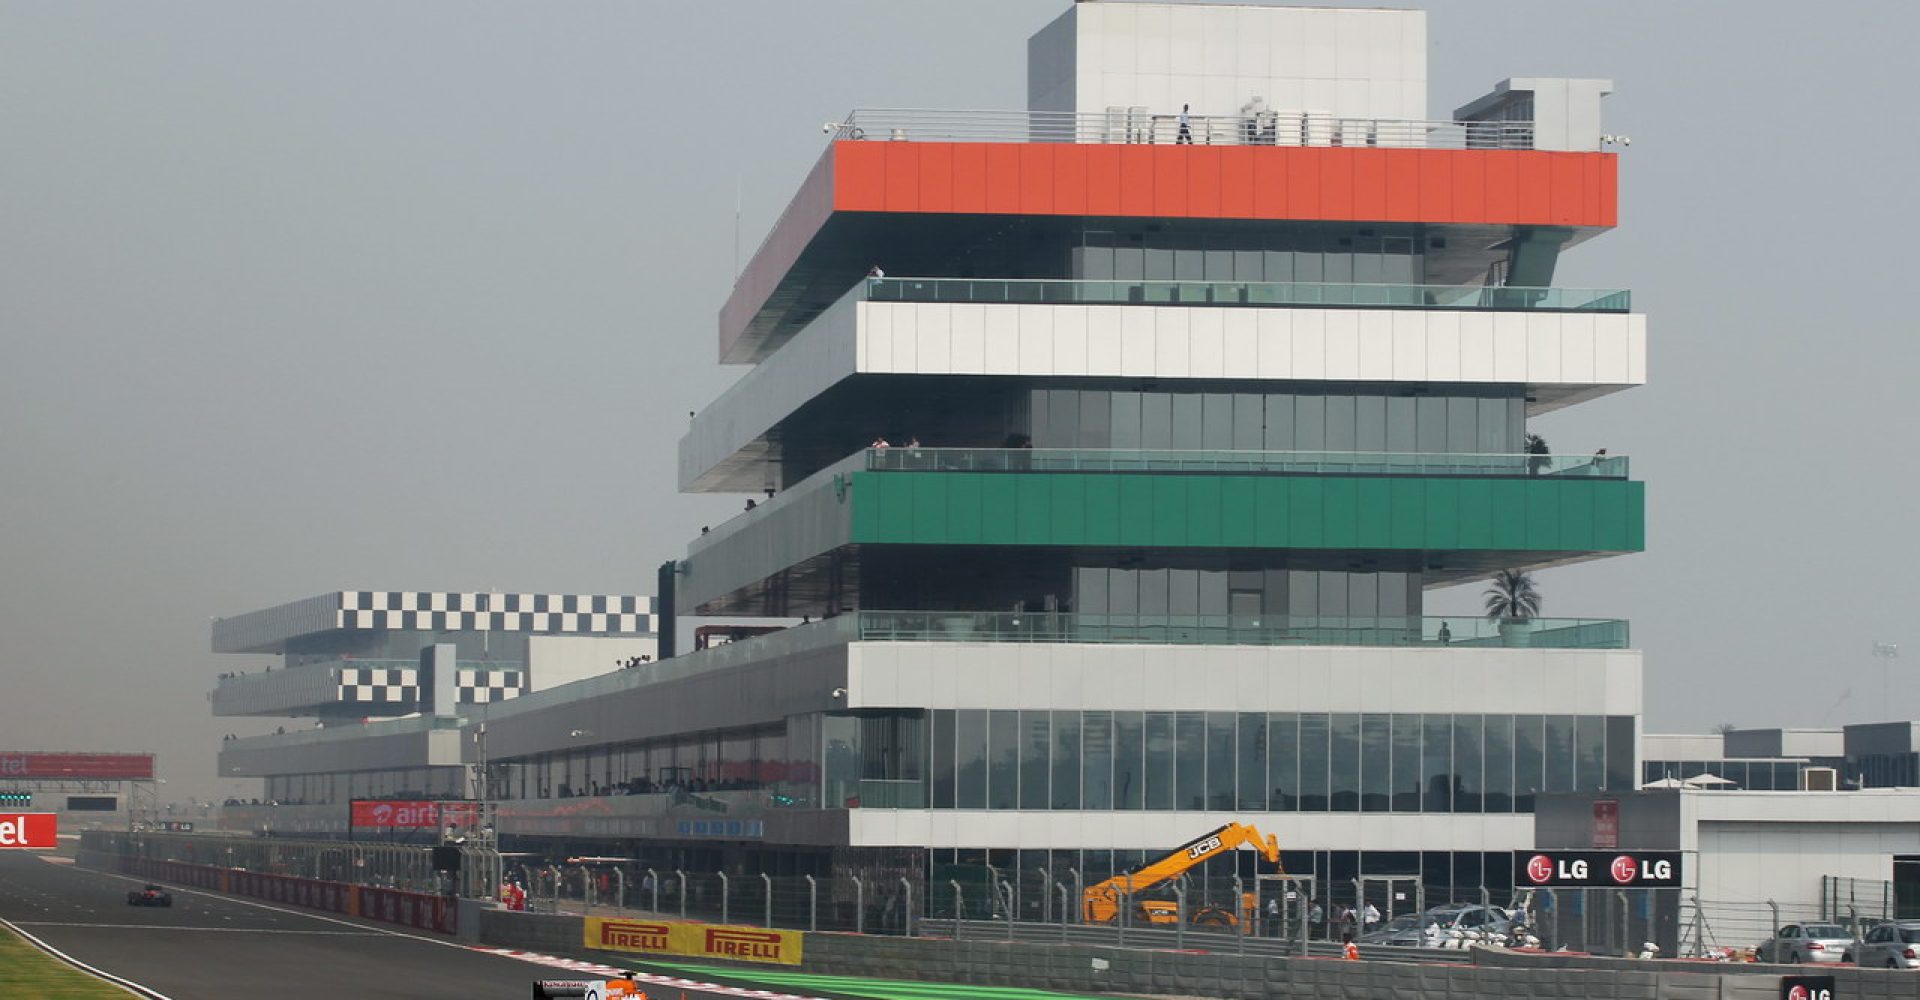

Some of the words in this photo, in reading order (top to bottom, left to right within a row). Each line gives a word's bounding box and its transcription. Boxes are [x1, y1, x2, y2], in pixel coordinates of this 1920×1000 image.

[396, 802, 458, 825] airt
[0, 816, 28, 845] el
[1189, 837, 1222, 859] JCB
[1558, 860, 1588, 879] LG
[1642, 860, 1671, 879] LG
[601, 922, 670, 950] PIRELLI
[705, 928, 781, 958] PIRELLI
[1810, 989, 1831, 1000] LG
